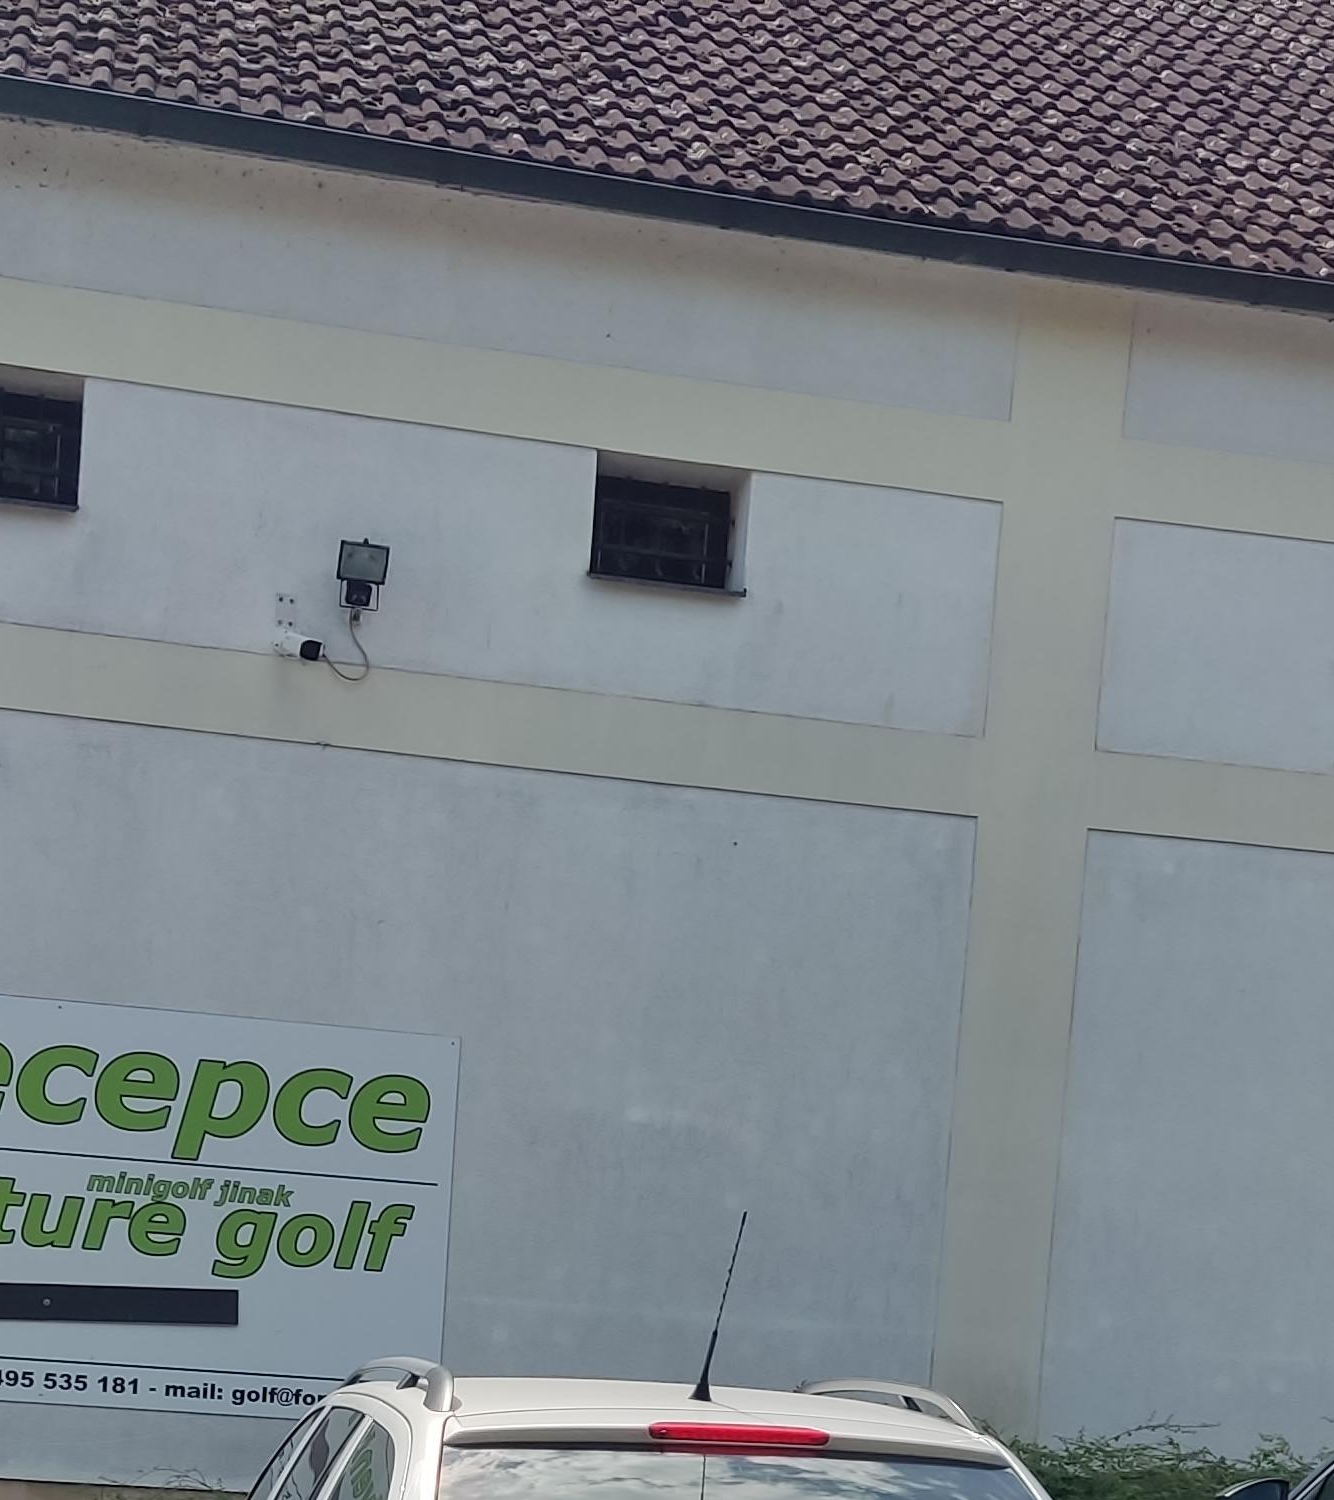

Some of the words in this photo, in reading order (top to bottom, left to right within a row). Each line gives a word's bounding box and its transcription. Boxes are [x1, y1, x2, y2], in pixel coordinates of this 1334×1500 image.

[87, 1171, 214, 1201] minigolf
[214, 1180, 294, 1207] jinak
[211, 1200, 415, 1279] golf
[43, 1373, 88, 1391] 535
[97, 1376, 140, 1395] 181
[165, 1382, 223, 1401] mail:
